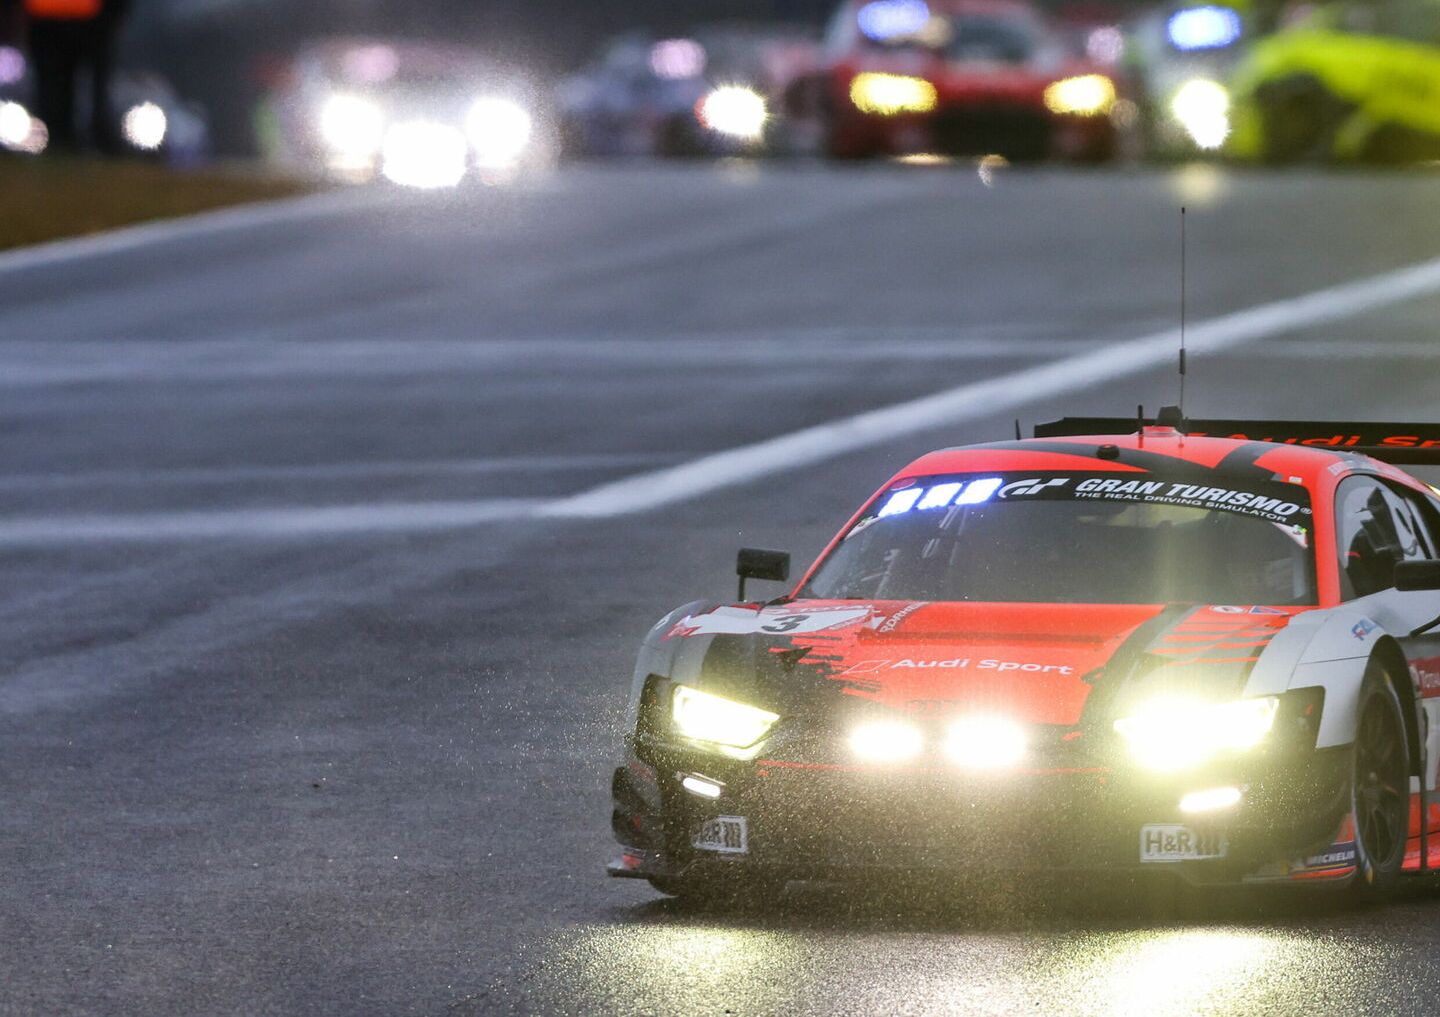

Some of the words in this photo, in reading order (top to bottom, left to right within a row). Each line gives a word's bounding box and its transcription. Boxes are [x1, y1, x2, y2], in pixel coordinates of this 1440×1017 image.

[1075, 477, 1160, 496] GRAN
[1074, 492, 1101, 500] THE
[1103, 492, 1141, 501] REAL
[1148, 495, 1202, 507] DRIVING
[1205, 501, 1287, 523] SIMULATOR
[760, 614, 811, 633] 3
[889, 658, 970, 669] Audi
[976, 659, 1075, 675] Sport
